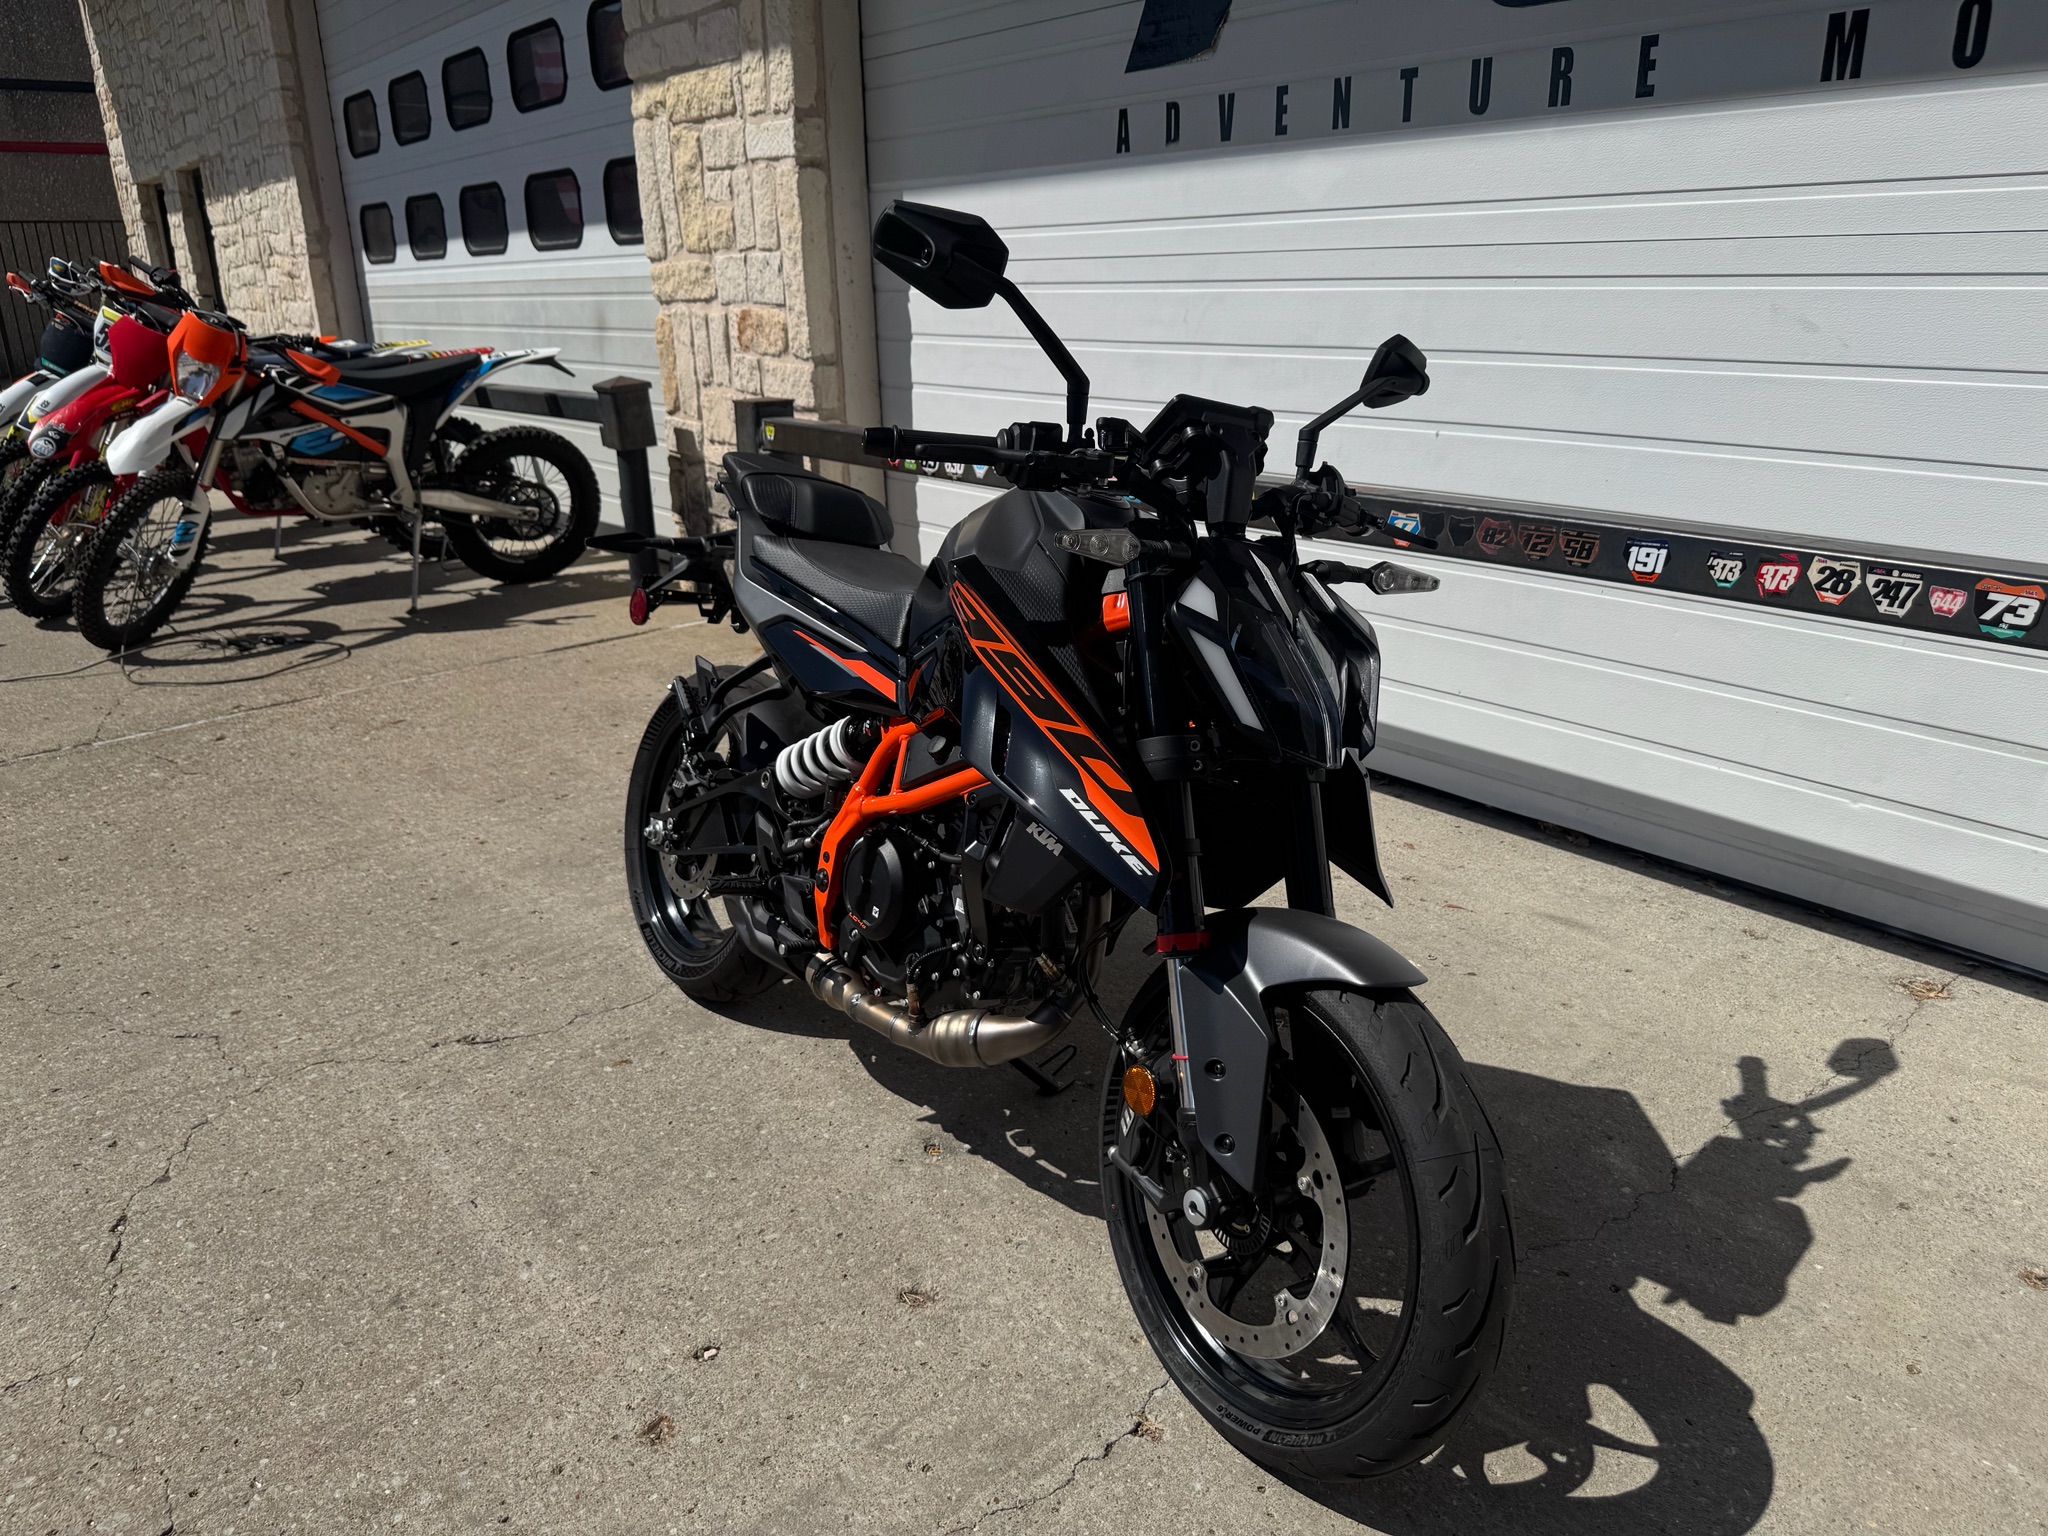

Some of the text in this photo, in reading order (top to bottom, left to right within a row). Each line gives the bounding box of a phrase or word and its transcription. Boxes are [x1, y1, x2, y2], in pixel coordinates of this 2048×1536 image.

[1116, 34, 1659, 154] ADVENTURE
[1481, 526, 1511, 546] 82
[1524, 534, 1549, 555] 12
[1628, 546, 1668, 574] 191
[1709, 558, 1743, 582] 373
[1759, 563, 1799, 591] 373
[1814, 566, 1857, 595] 28
[1871, 574, 1921, 609] 247
[1930, 591, 1964, 612] 644
[1978, 592, 2041, 626] 73
[1026, 822, 1064, 857] KTM
[1059, 788, 1153, 877] DUKE
[643, 927, 676, 970] MICHELIN
[1224, 1411, 1261, 1436] POWER
[1269, 1430, 1324, 1446] MICHELIN
